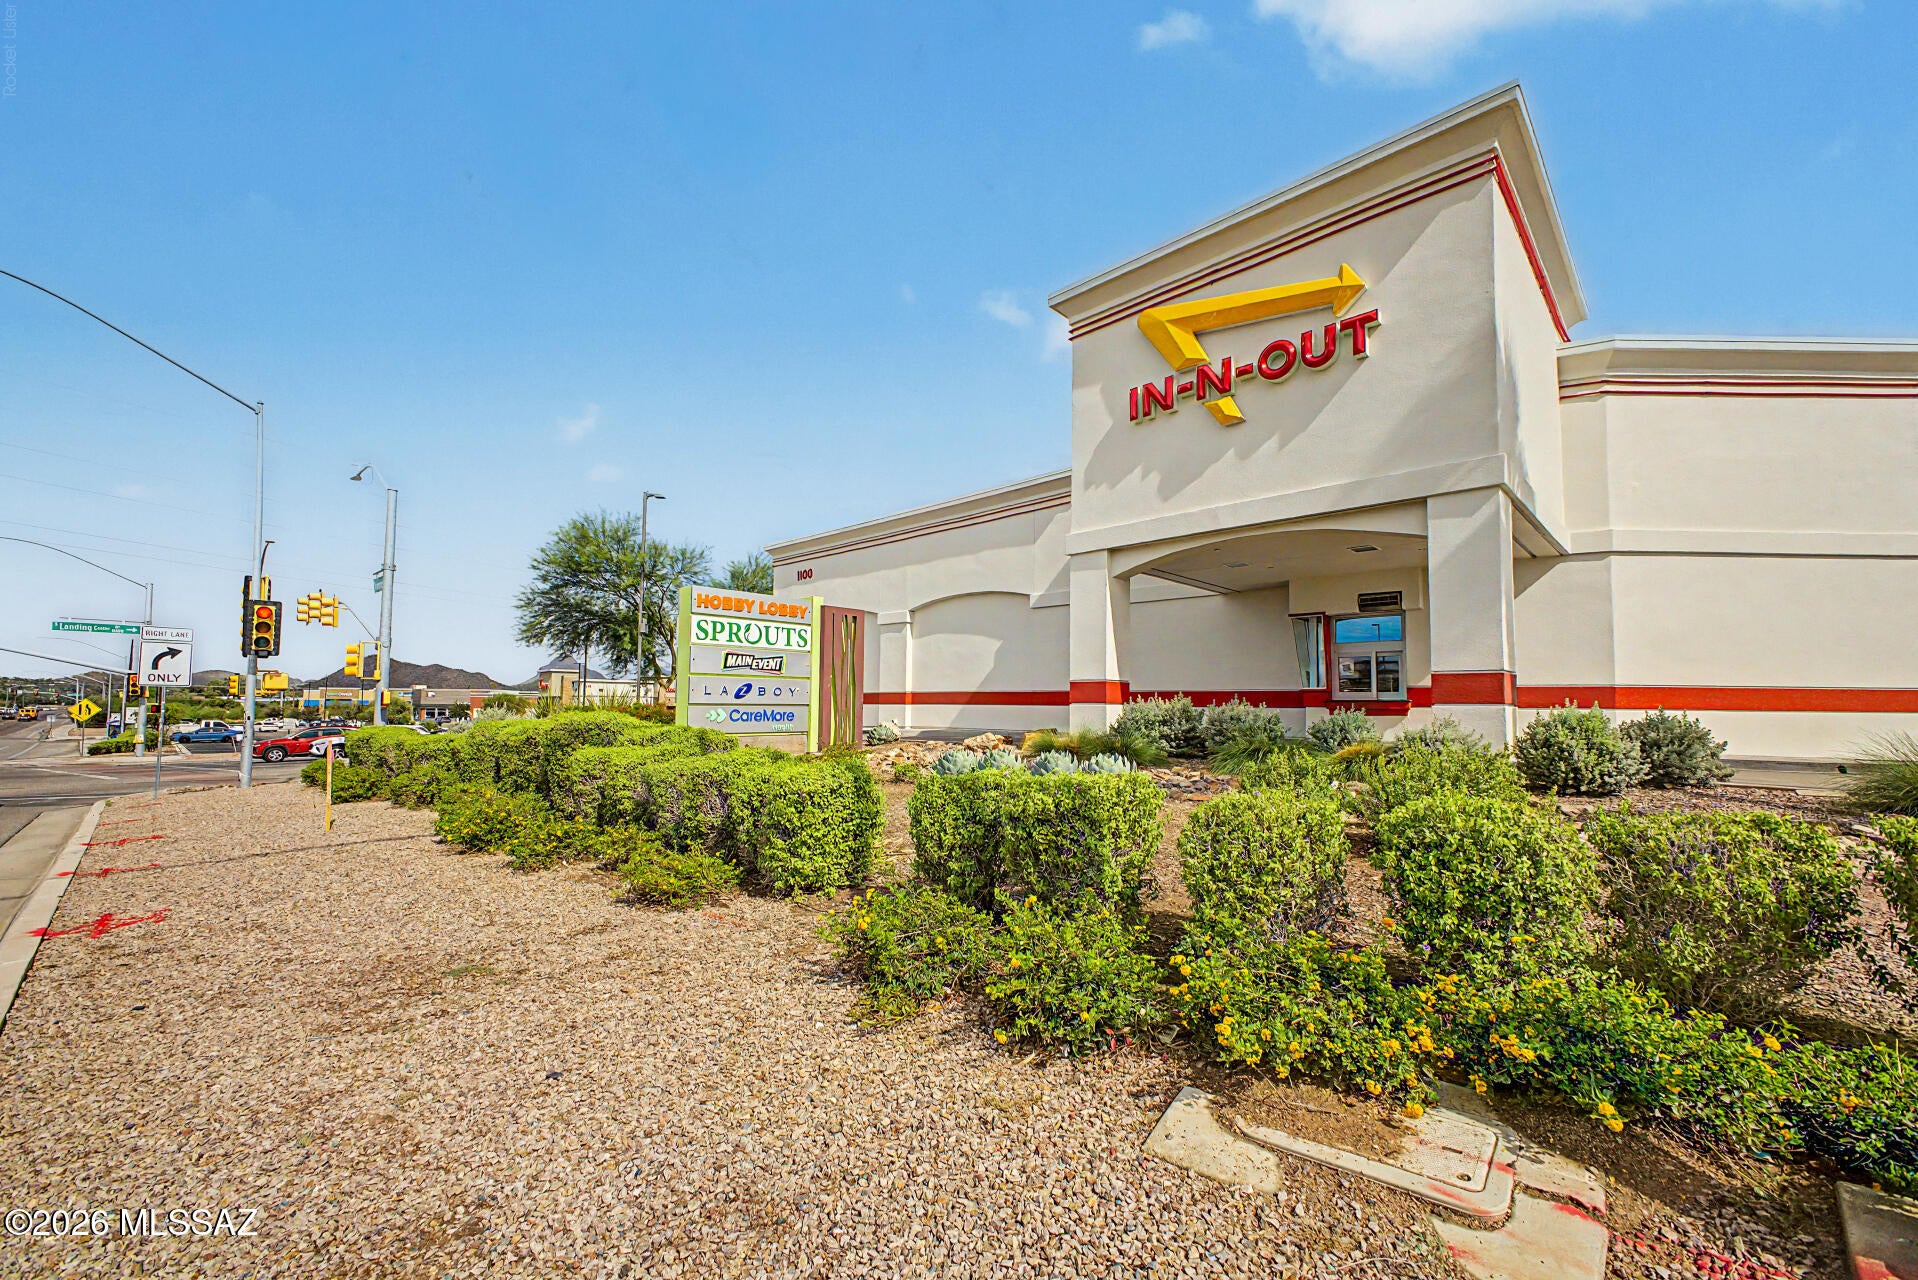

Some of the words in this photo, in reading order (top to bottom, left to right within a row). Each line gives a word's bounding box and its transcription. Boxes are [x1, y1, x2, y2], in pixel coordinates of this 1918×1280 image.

[1129, 308, 1382, 425] IN-N-OUT
[797, 568, 813, 581] 1100
[696, 593, 755, 613] HOBBY
[758, 600, 809, 619] LOBBY
[60, 622, 92, 632] Landing
[145, 629, 168, 637] RIGHT
[170, 631, 189, 639] LANE
[695, 619, 808, 648] SPROUTS
[726, 654, 753, 667] MAIN
[751, 657, 783, 671] EVENT
[147, 673, 182, 683] ONLY
[729, 708, 795, 722] CareMore
